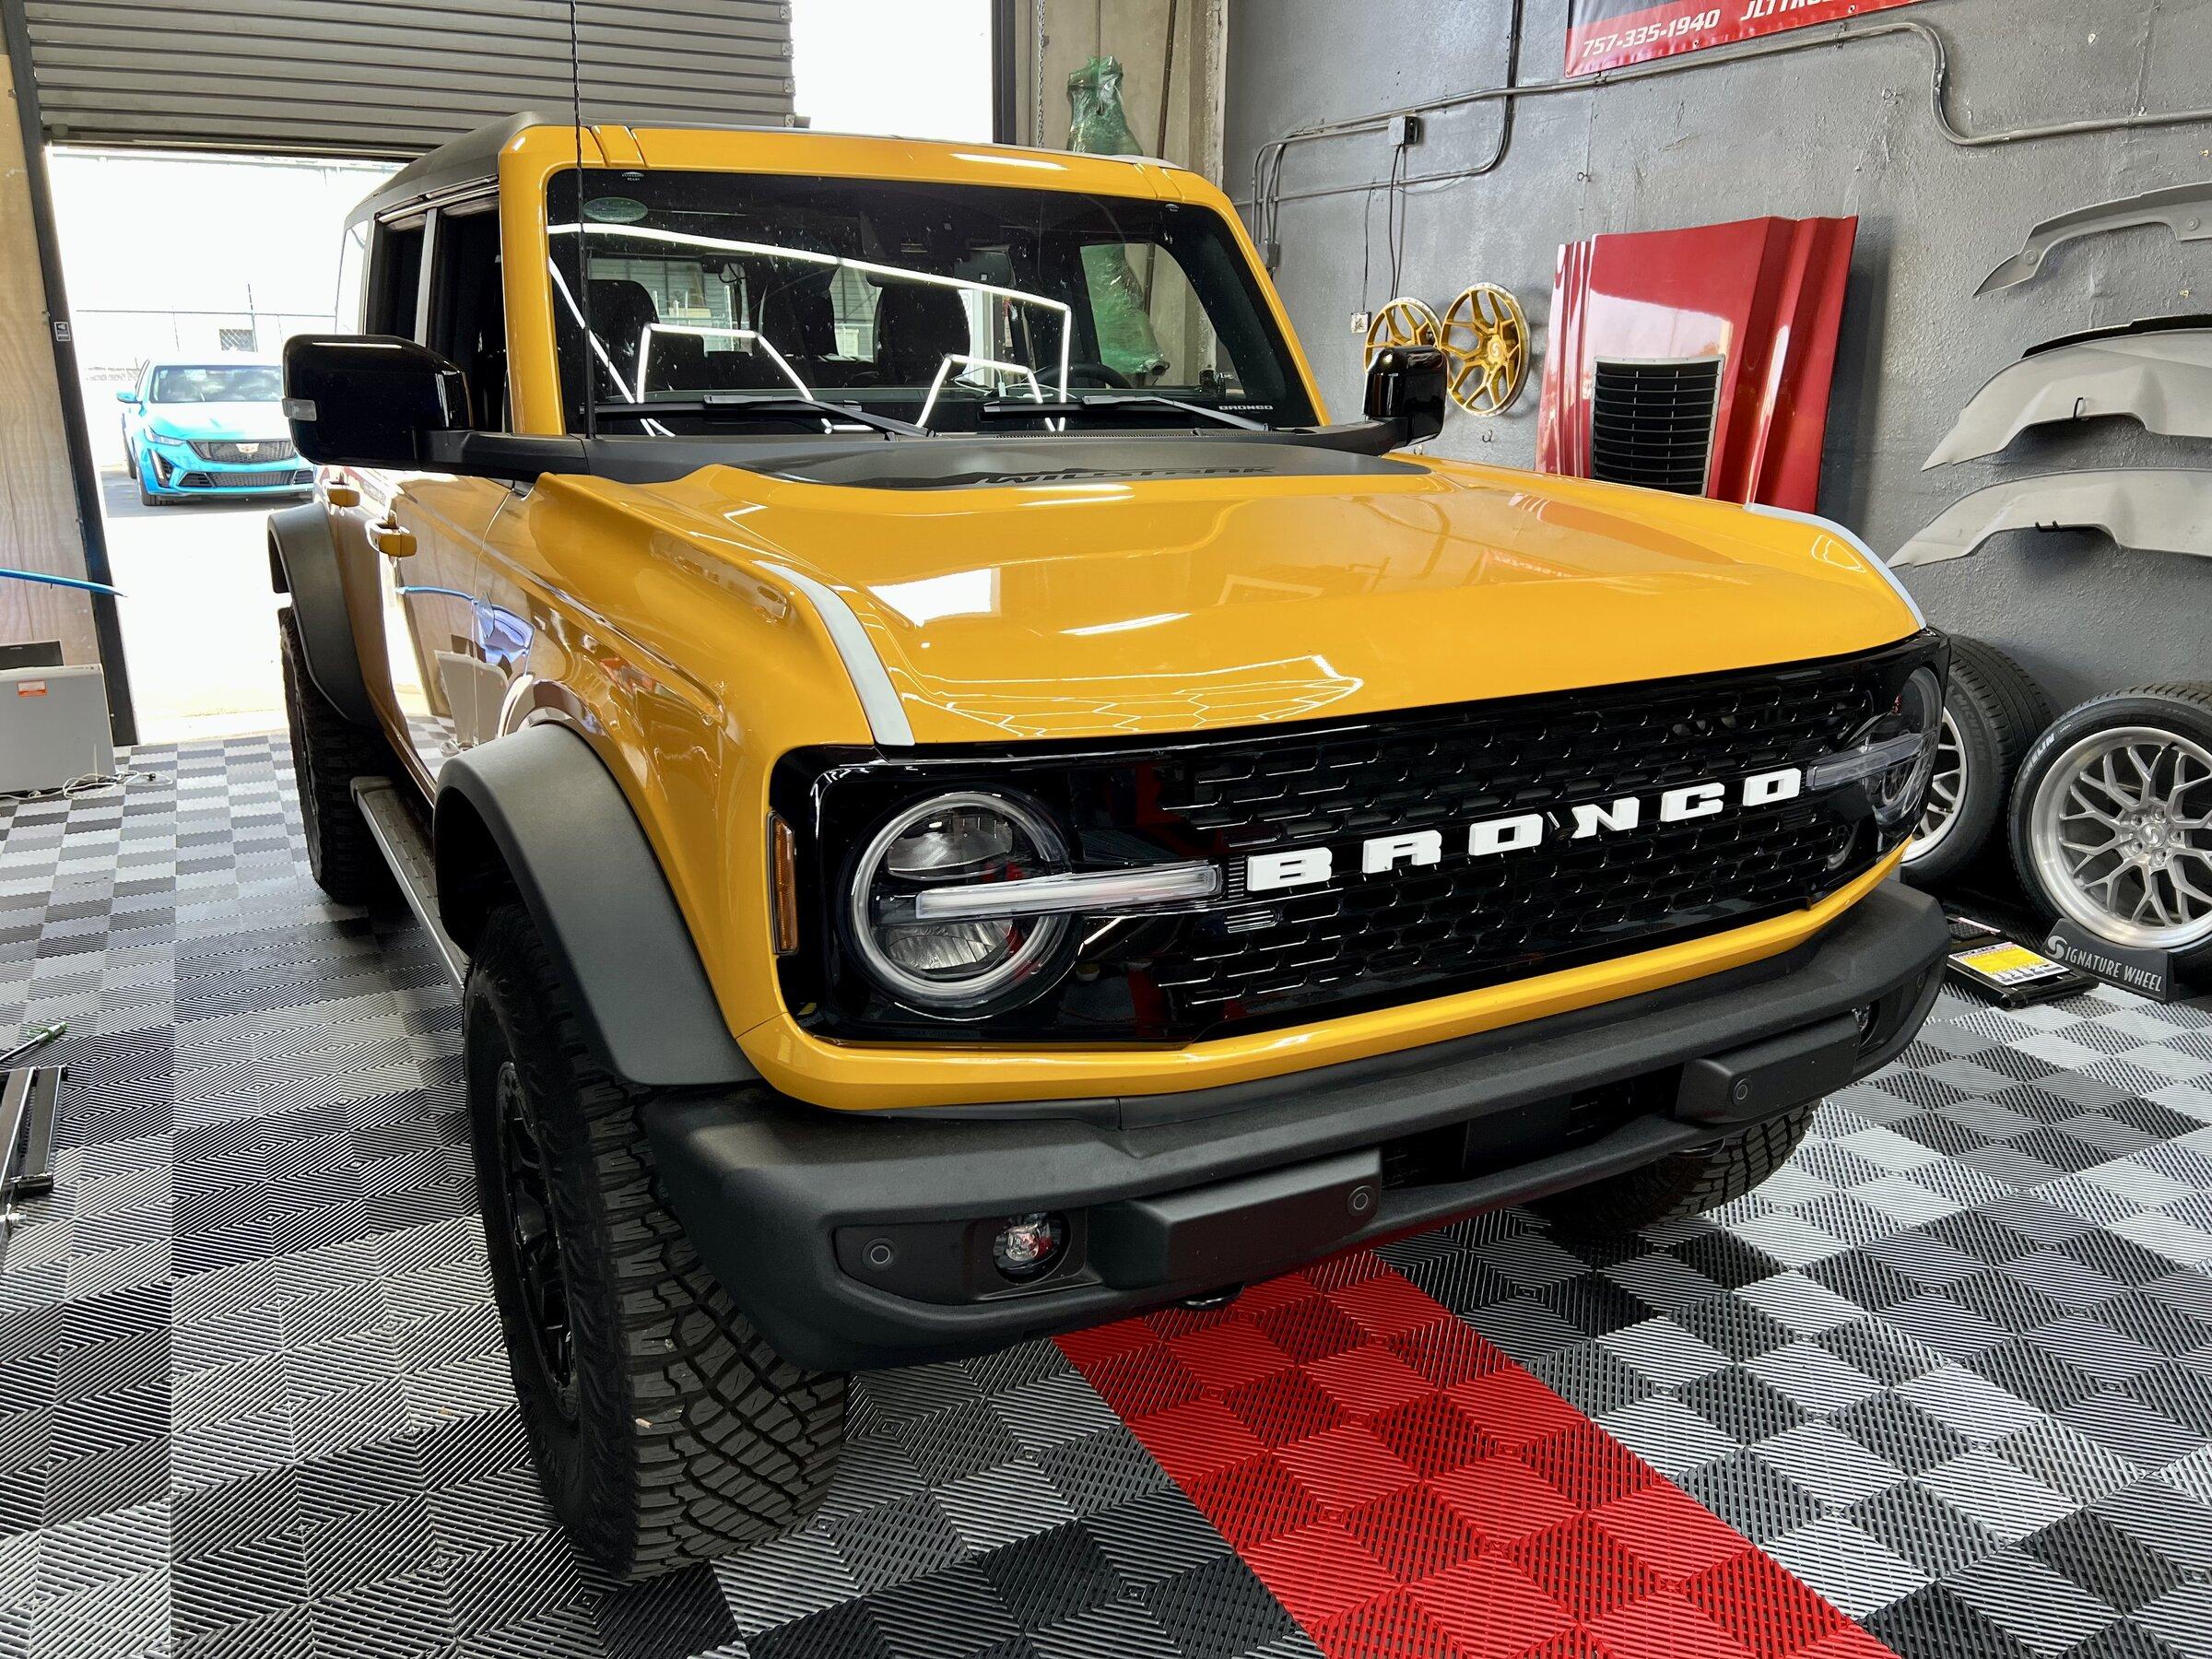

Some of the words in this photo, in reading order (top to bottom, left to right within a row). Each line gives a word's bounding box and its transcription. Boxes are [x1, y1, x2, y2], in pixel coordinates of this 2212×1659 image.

[1582, 8, 1721, 58] 757-335-1940
[1247, 768, 1802, 892] BRONCO
[2045, 935, 2122, 978] SIGNATURE
[2124, 965, 2162, 993] WHEEL
